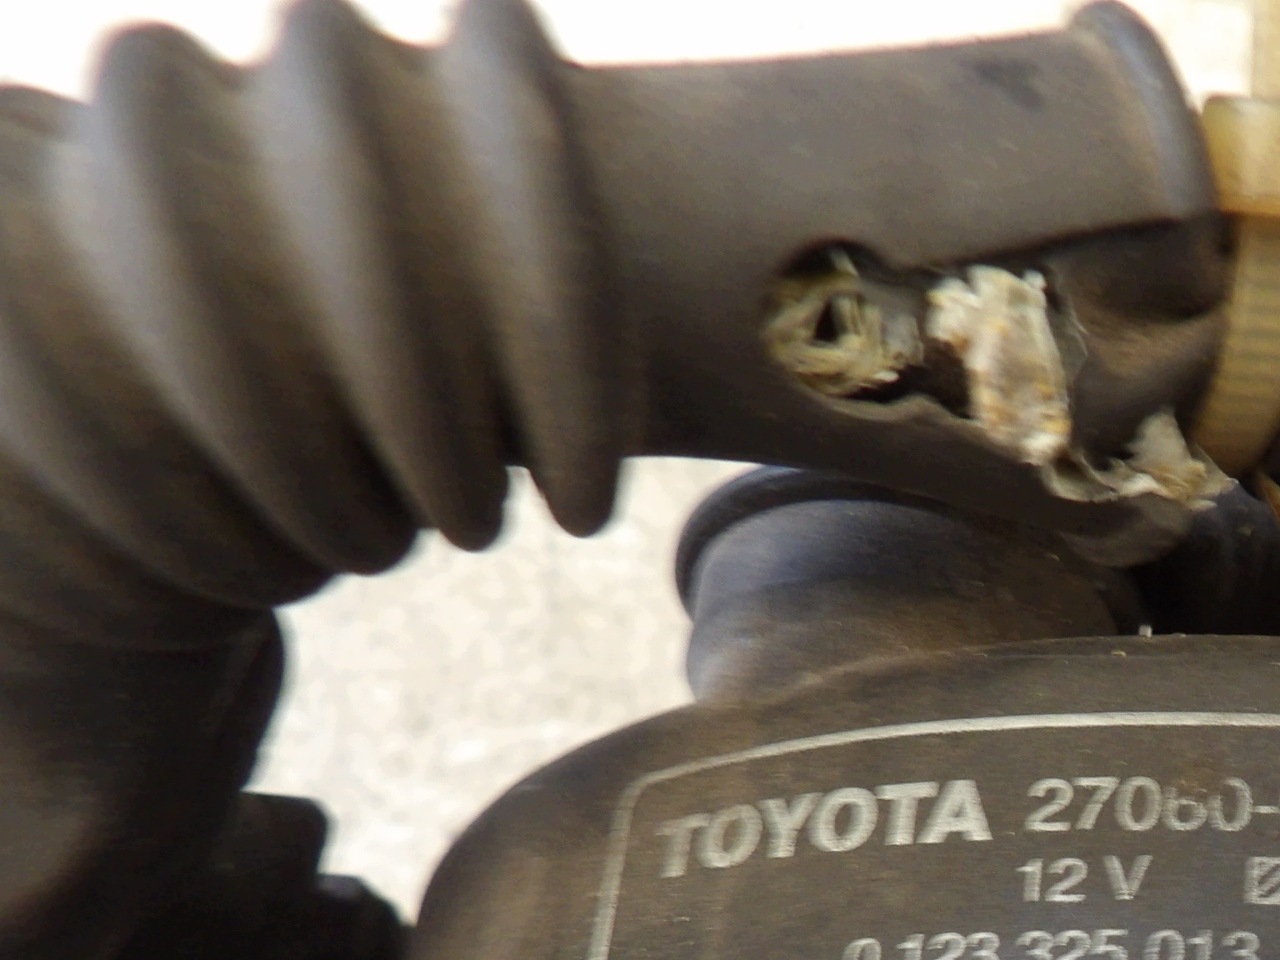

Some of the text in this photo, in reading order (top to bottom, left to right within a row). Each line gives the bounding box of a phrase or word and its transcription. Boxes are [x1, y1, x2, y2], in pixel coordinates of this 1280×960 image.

[655, 780, 993, 878] TOYOTA
[1016, 854, 1153, 902] 12 V
